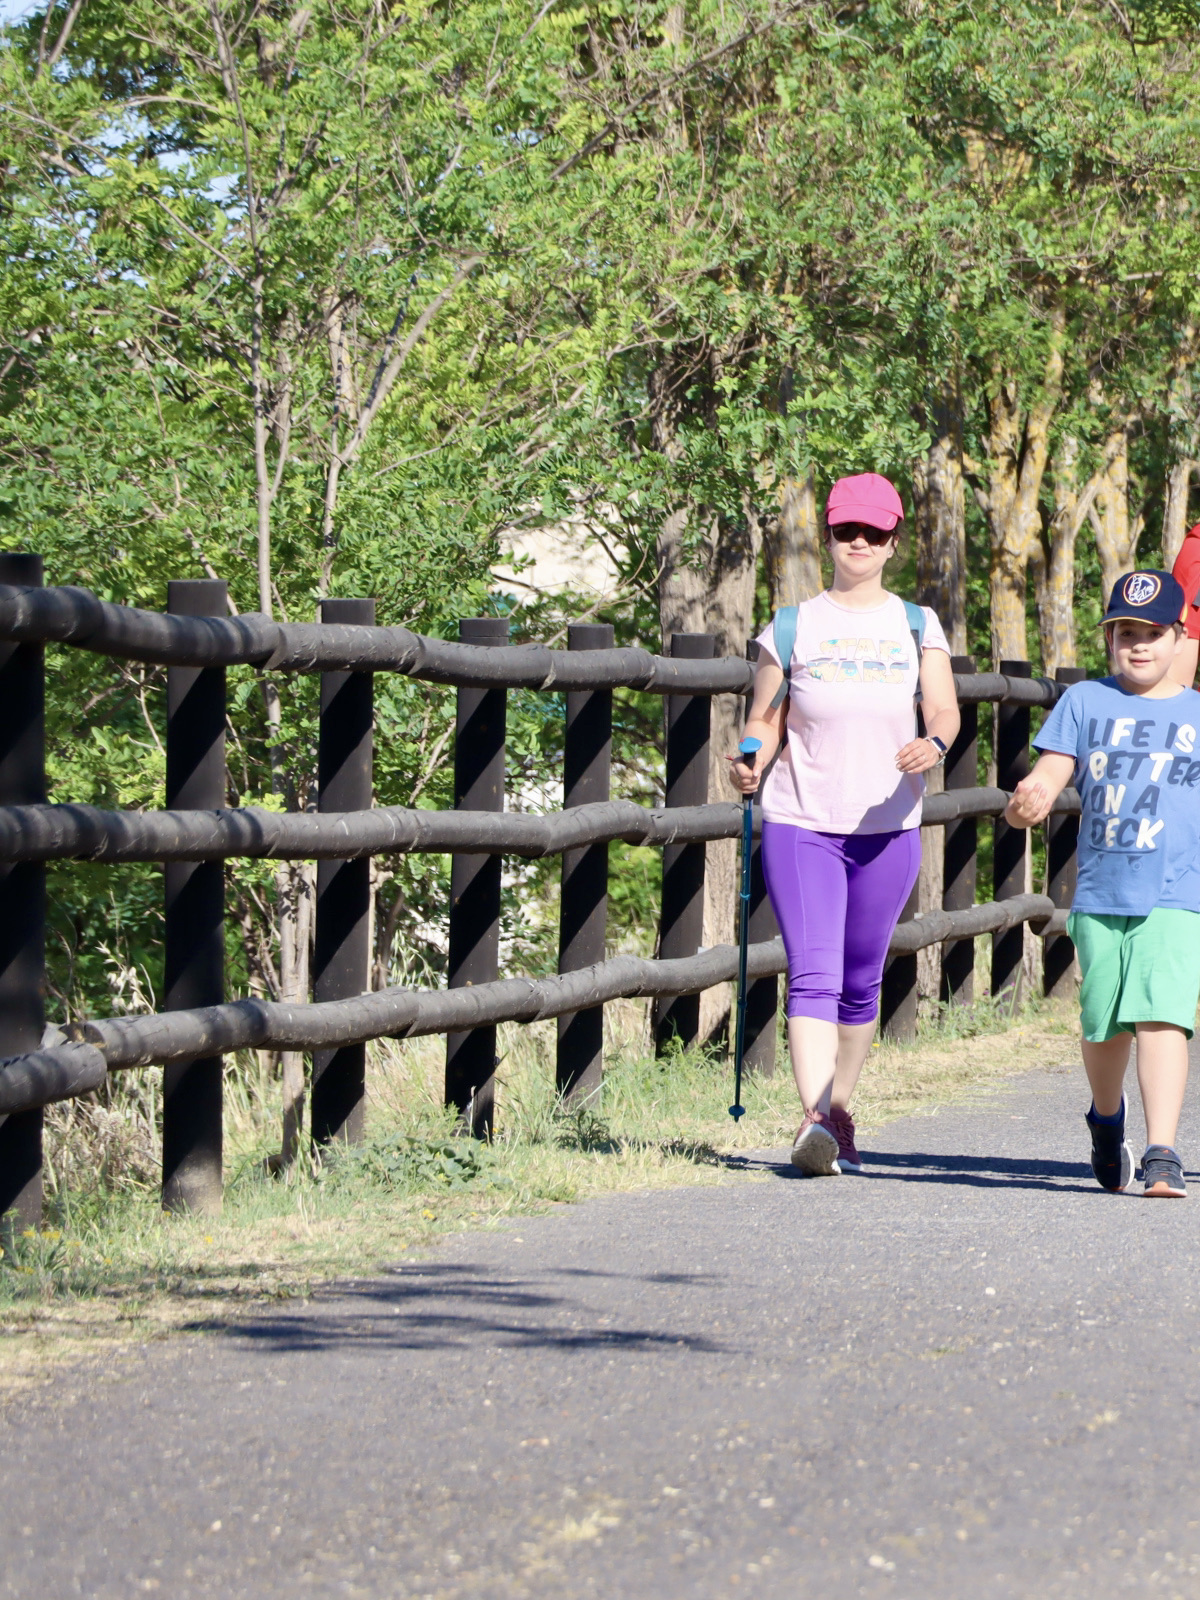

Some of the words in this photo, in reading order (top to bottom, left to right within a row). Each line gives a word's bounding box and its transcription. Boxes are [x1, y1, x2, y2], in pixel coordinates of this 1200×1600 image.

[805, 638, 910, 662] STAR
[805, 660, 910, 684] WARS
[1088, 717, 1156, 749] LIFE
[1165, 721, 1197, 753] IS
[1090, 784, 1126, 815] ON
[1132, 784, 1161, 816] A
[1090, 817, 1165, 849] DECK
